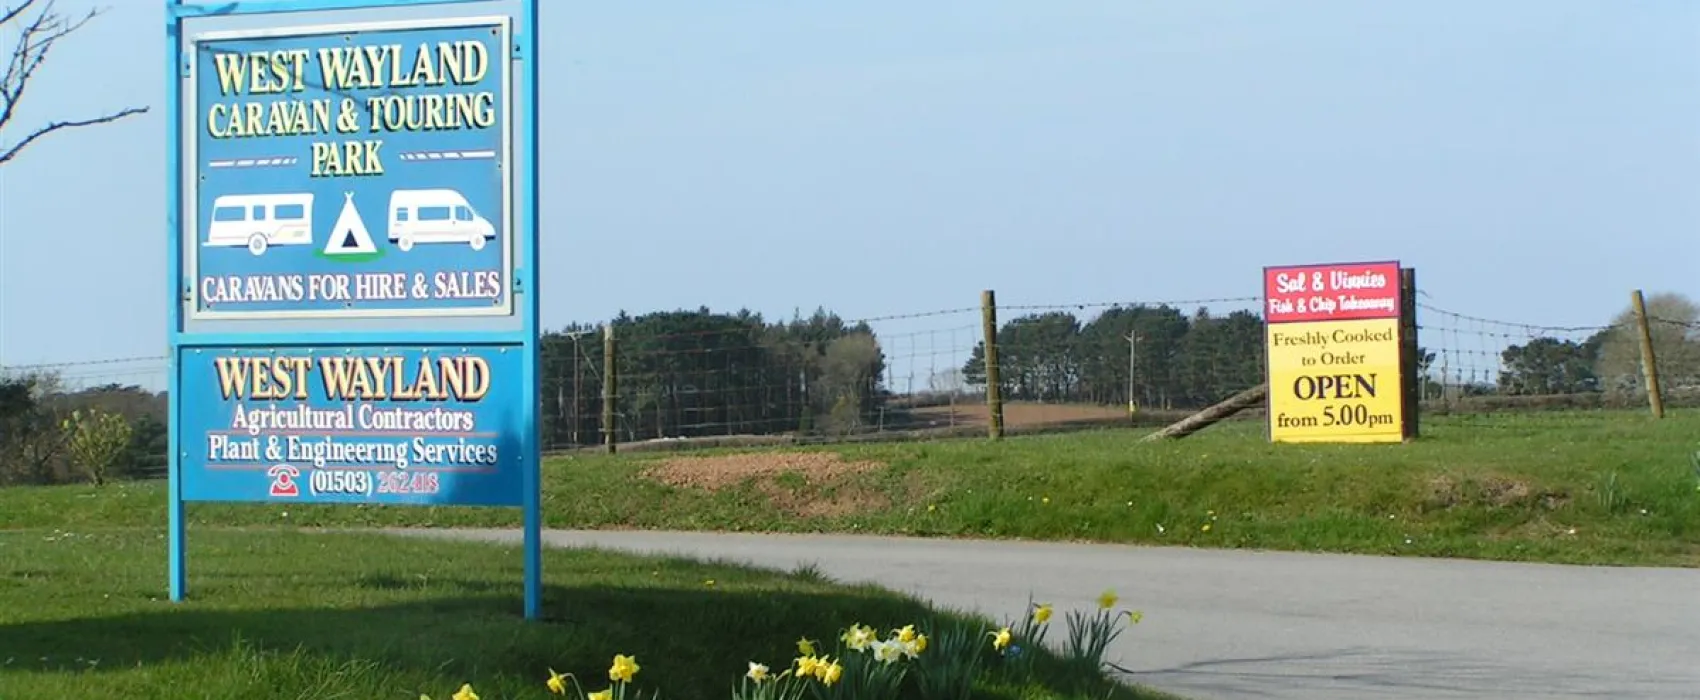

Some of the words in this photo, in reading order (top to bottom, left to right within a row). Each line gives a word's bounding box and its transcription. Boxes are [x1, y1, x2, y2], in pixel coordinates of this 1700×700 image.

[214, 50, 310, 95] WEST
[318, 40, 489, 90] WAYLAND
[208, 99, 331, 138] CARAVAN
[336, 99, 360, 132] &
[366, 92, 496, 131] TOURING
[310, 140, 384, 177] PARK
[202, 274, 303, 302] CARAVANS
[309, 274, 350, 299] FOR
[355, 273, 407, 299] HIRE
[411, 273, 429, 298] &
[434, 271, 501, 297] SALES
[1276, 272, 1307, 293] Sal
[1311, 271, 1325, 292] &
[1330, 269, 1387, 290] Vinnies
[1268, 298, 1294, 314] Fish
[1297, 297, 1307, 313] &
[1308, 296, 1337, 314] Chip
[1338, 295, 1395, 312] Takeaway
[1273, 331, 1329, 349] Freshly
[1332, 327, 1393, 344] Cooked
[1301, 355, 1317, 366] to
[1321, 352, 1366, 365] Order
[215, 357, 313, 400] WEST
[319, 356, 491, 401] WAYLAND
[1293, 373, 1377, 401] OPEN
[232, 404, 354, 435] Agricultural
[358, 408, 474, 431] Contractors
[1277, 412, 1319, 428] from
[1322, 403, 1394, 428] 5.00pm
[209, 434, 261, 461] Plant
[265, 435, 284, 461] &
[288, 437, 409, 468] Engineering
[412, 437, 498, 465] Services
[309, 470, 373, 497] (01503)
